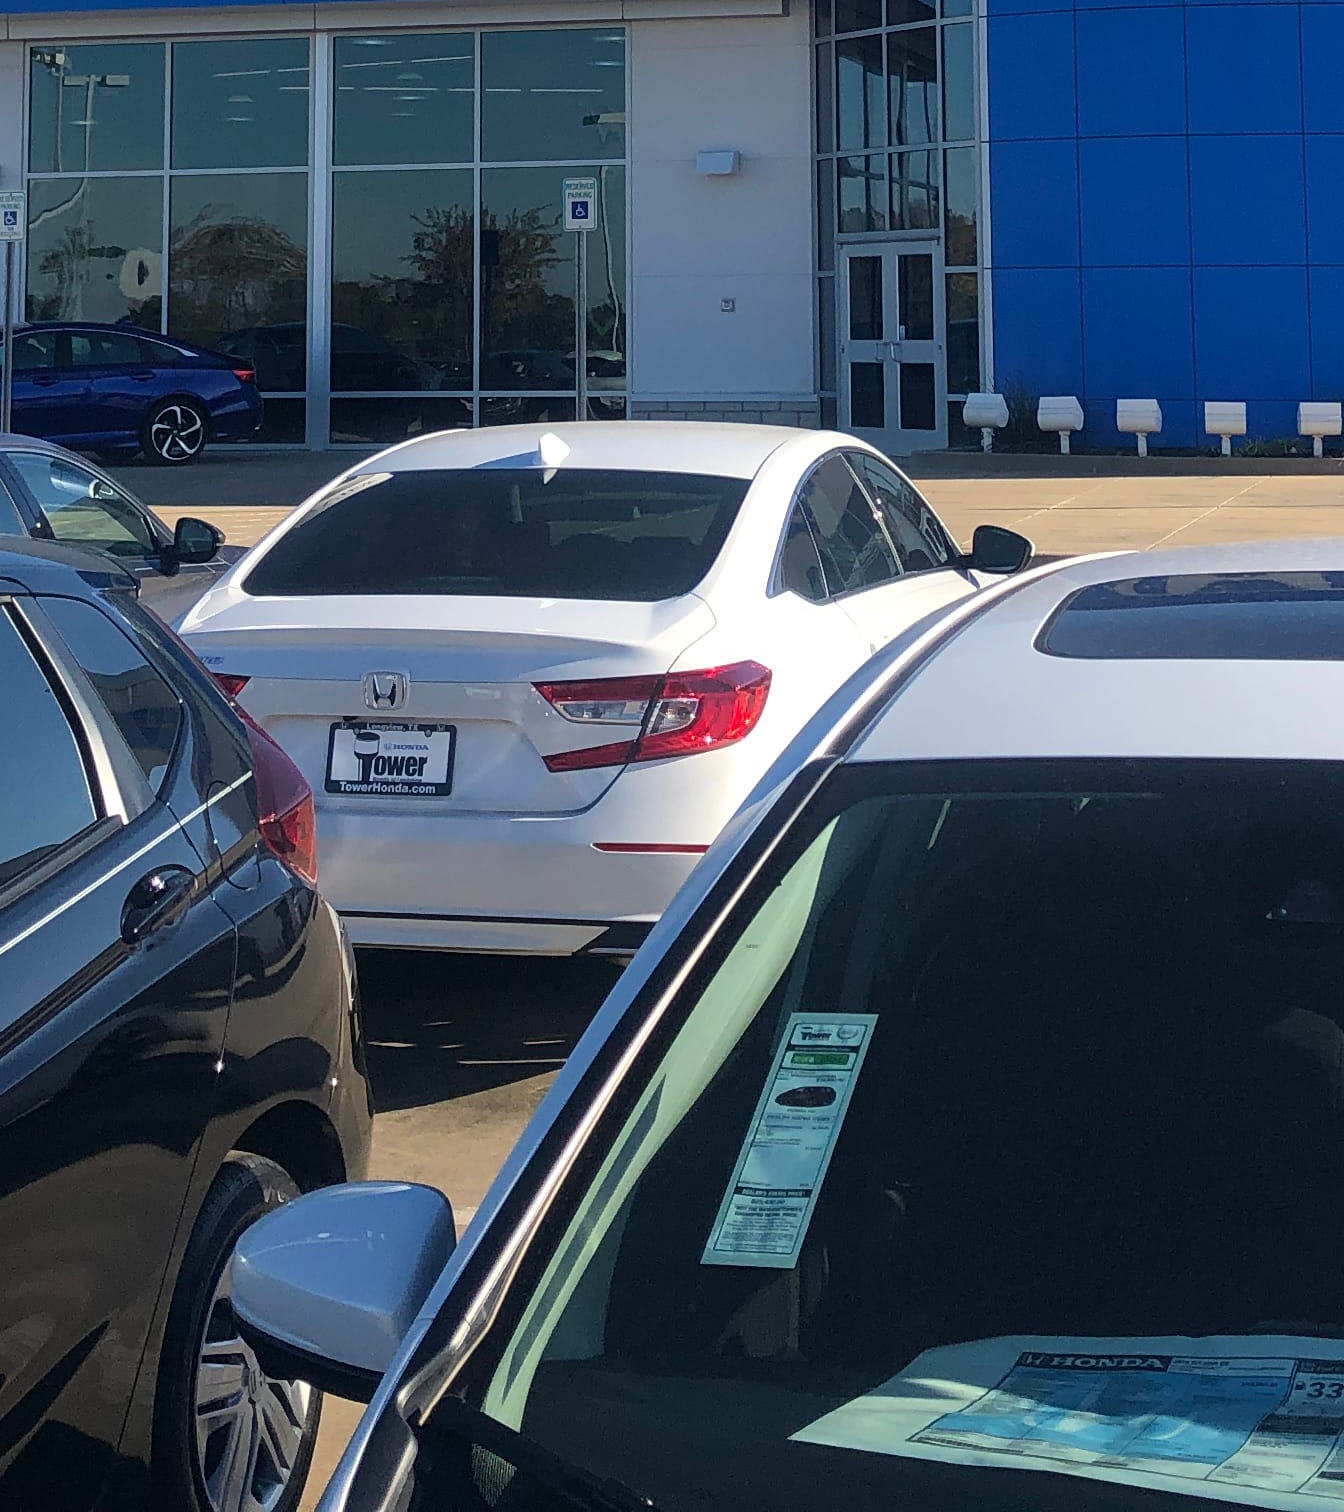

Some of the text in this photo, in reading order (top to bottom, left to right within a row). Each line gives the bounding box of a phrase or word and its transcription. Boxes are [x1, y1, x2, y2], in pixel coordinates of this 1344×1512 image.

[339, 781, 436, 794] TowerHonda.com
[1050, 1357, 1164, 1368] HONDA
[1306, 1382, 1344, 1398] 33
